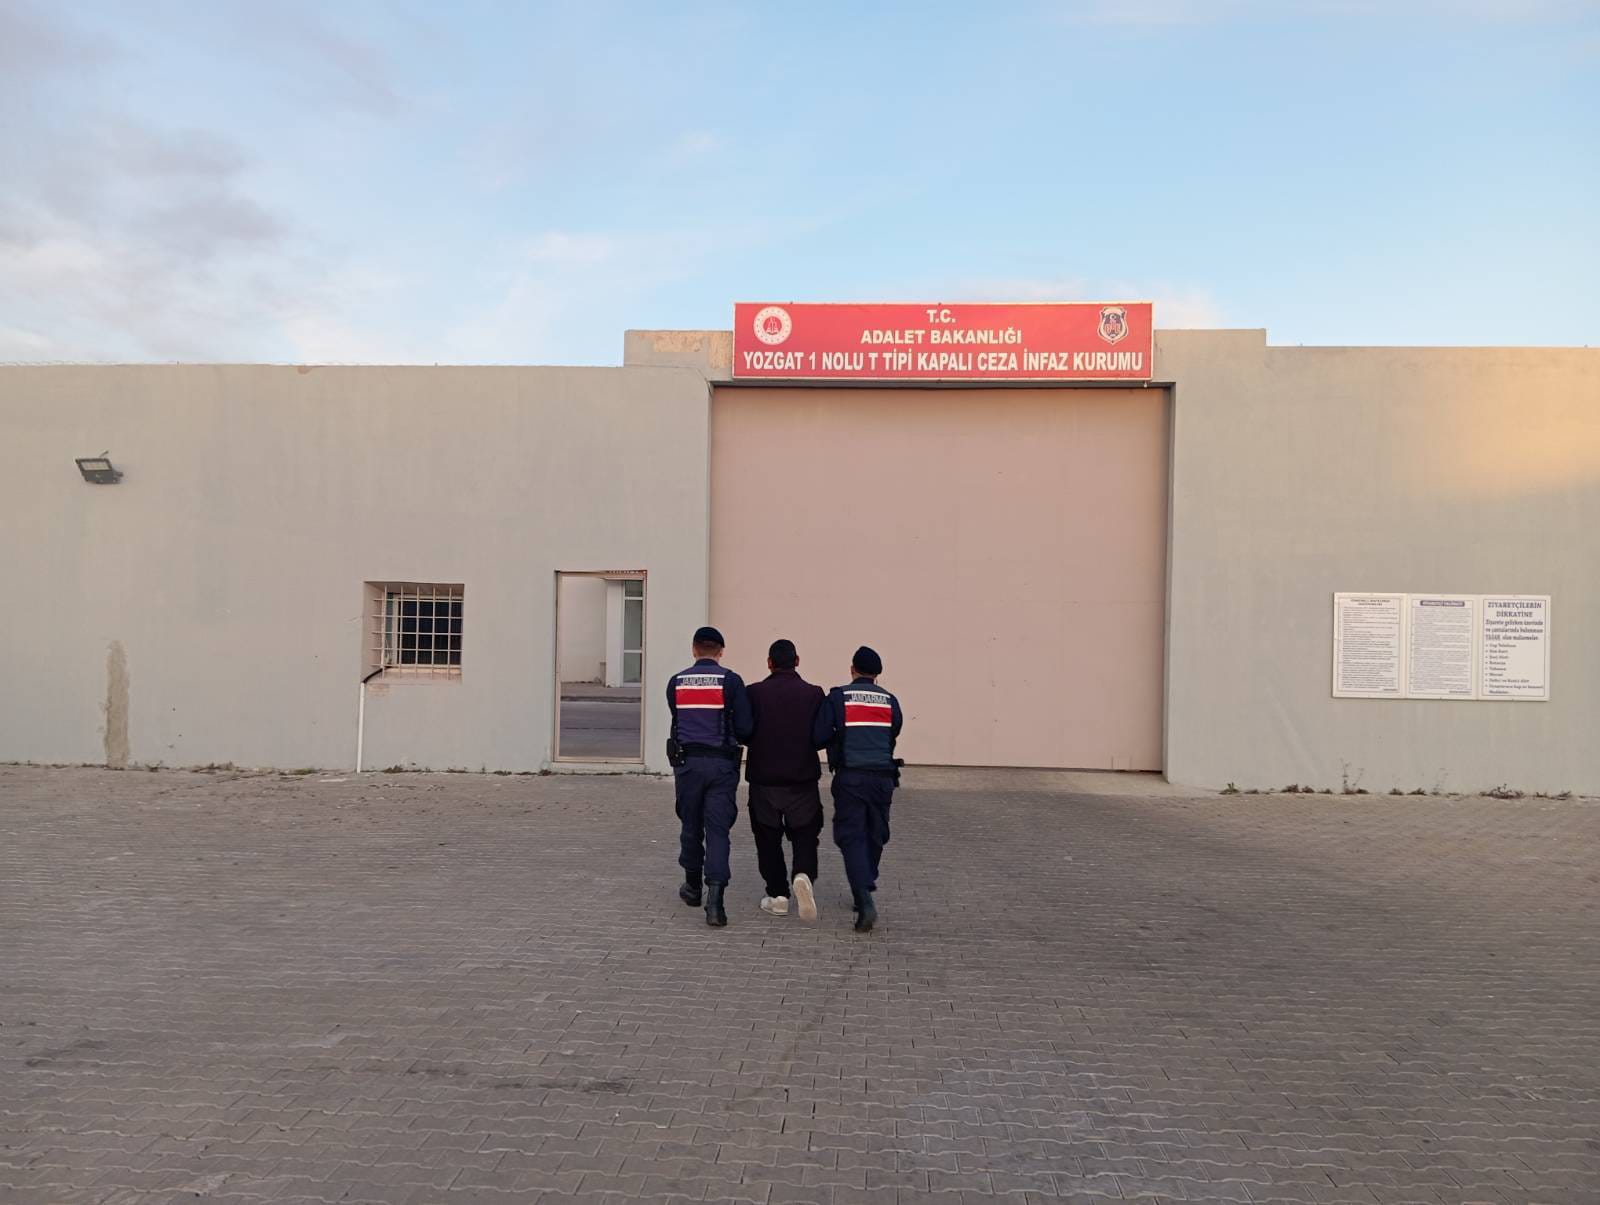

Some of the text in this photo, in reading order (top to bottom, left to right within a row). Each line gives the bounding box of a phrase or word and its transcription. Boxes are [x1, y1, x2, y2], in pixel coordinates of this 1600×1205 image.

[926, 309, 956, 323] T.C.
[861, 327, 1022, 344] ADALET BAKANLIĞI
[744, 348, 1143, 371] YOZGAT 1 NOLU T TİPİ KAPALI CEZA İNFAZ KURUMU
[680, 677, 720, 687] JANDARMA
[848, 693, 888, 705] JANDARMA
